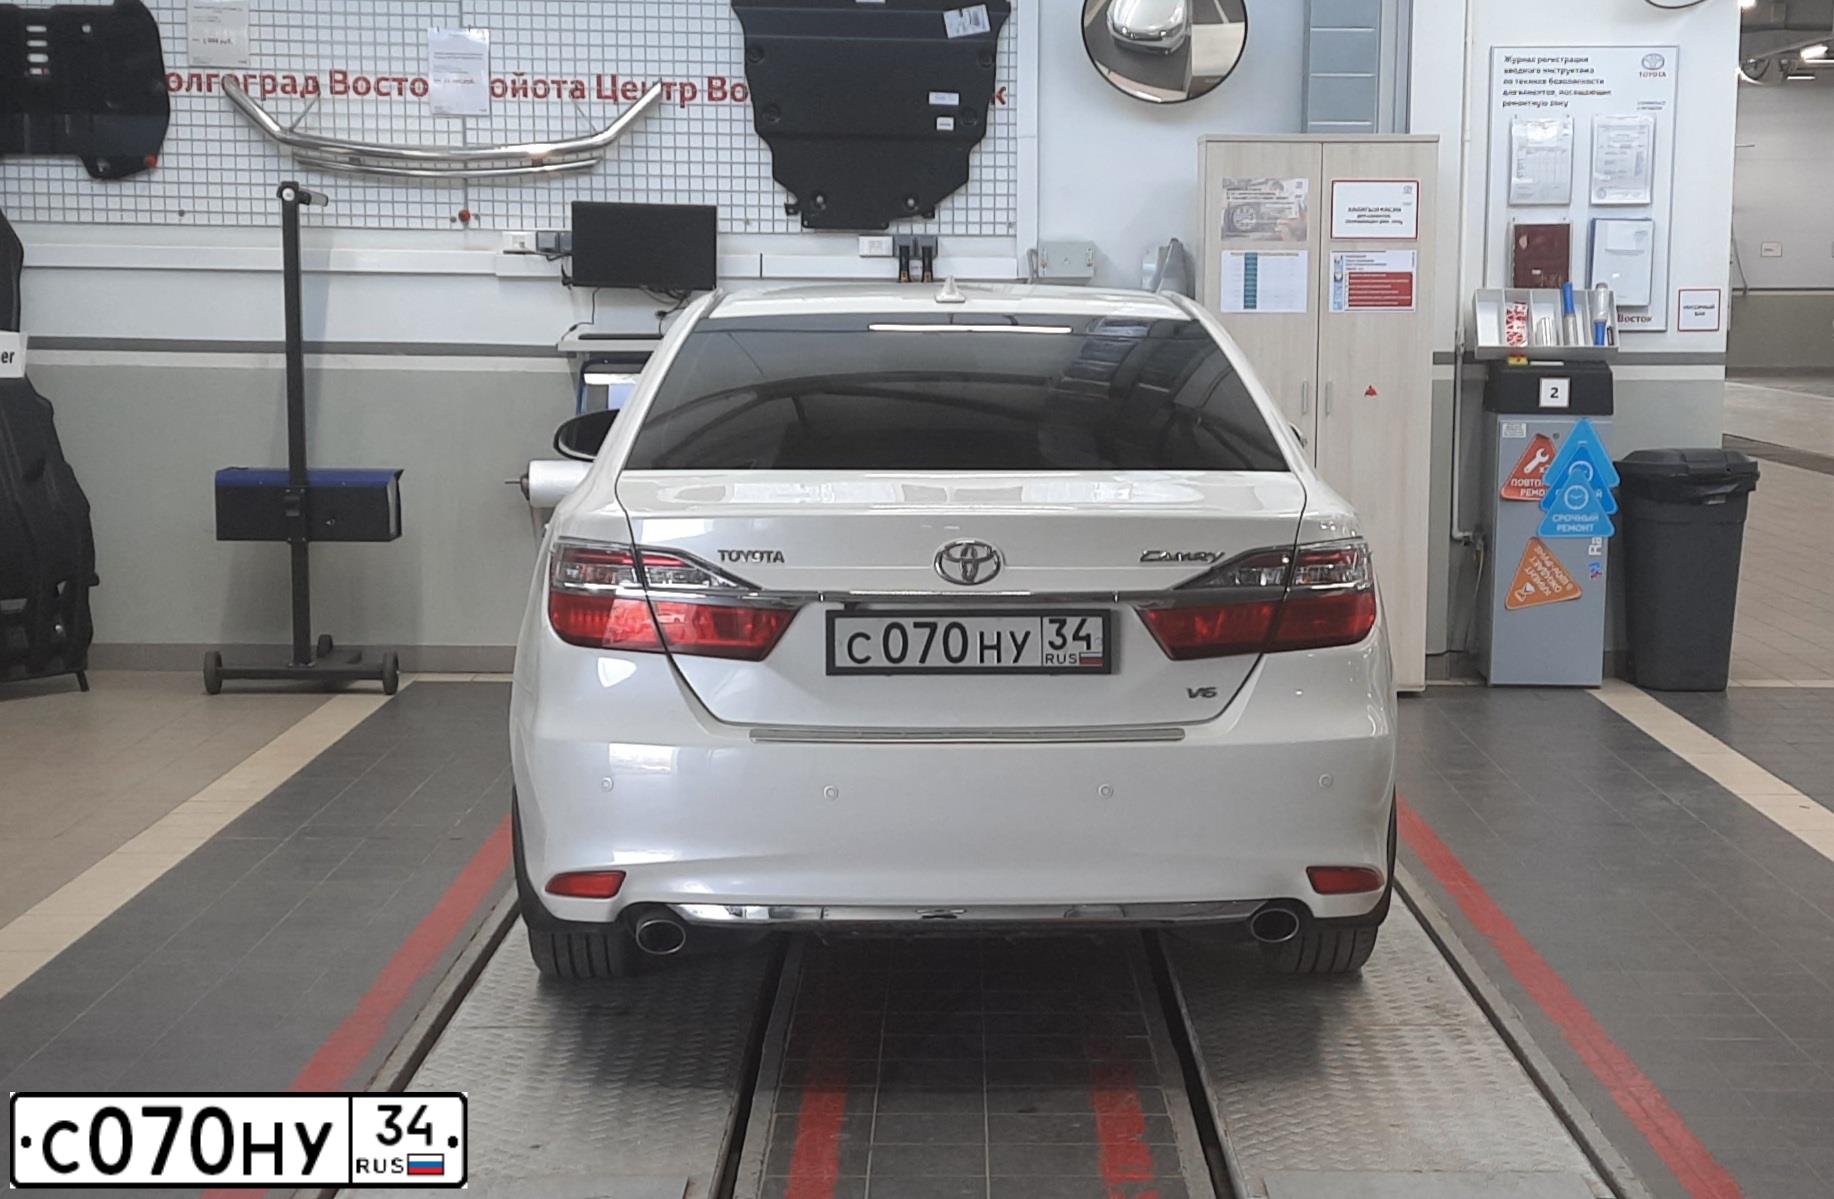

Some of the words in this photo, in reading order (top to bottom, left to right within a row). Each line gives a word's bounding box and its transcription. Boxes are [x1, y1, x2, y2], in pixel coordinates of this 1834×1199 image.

[165, 71, 321, 101] олгоград
[329, 69, 429, 97] Восто
[490, 71, 586, 99] ойота
[707, 76, 749, 102] Во
[1, 351, 15, 364] er
[1550, 387, 1559, 399] 2
[1520, 488, 1546, 497] РЕМО
[1556, 523, 1595, 532] РЕМОНТ
[717, 549, 785, 563] TOYOTA
[1048, 618, 1092, 651] 34
[1045, 653, 1077, 665] RUS
[1185, 686, 1218, 699] V6
